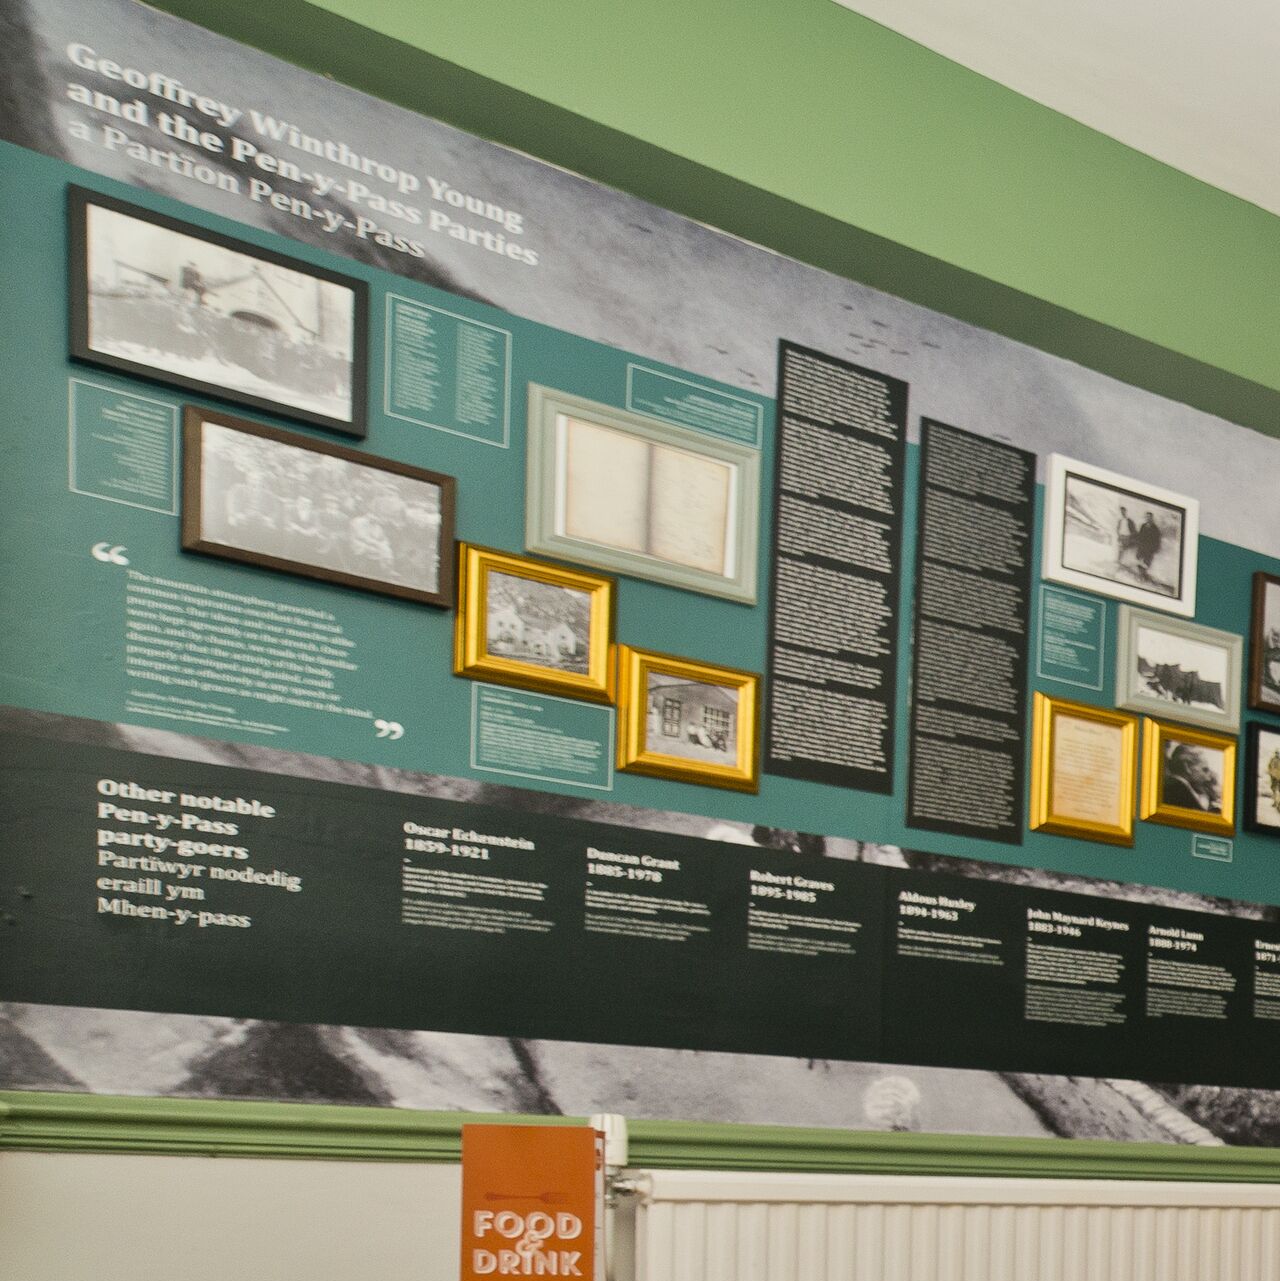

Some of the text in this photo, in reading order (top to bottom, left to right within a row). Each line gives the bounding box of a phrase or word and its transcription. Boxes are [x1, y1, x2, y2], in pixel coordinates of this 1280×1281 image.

[67, 43, 524, 234] Geoffrey Winthrop Young
[67, 82, 539, 266] and the Pen-y-Pass Parties
[67, 120, 93, 143] a
[249, 177, 425, 258] Pen-y-Pass
[97, 779, 276, 818] Other notable
[97, 802, 239, 836] Pen-y-Pass
[97, 829, 249, 860] party-goers
[403, 821, 536, 850] Oscar Eckenstein
[404, 838, 490, 860] 1859-1921
[586, 847, 681, 870] Duncan Grant
[97, 876, 205, 900] eraill ym
[210, 867, 302, 892] nodedig
[750, 869, 835, 891] Robert Graves
[97, 897, 252, 928] Mhen-y-pass
[899, 890, 938, 906] Aldous
[1027, 907, 1130, 932] John Maynard Keynes
[472, 1209, 583, 1240] FOOD
[516, 1229, 545, 1257] &
[472, 1248, 583, 1277] DRINK
